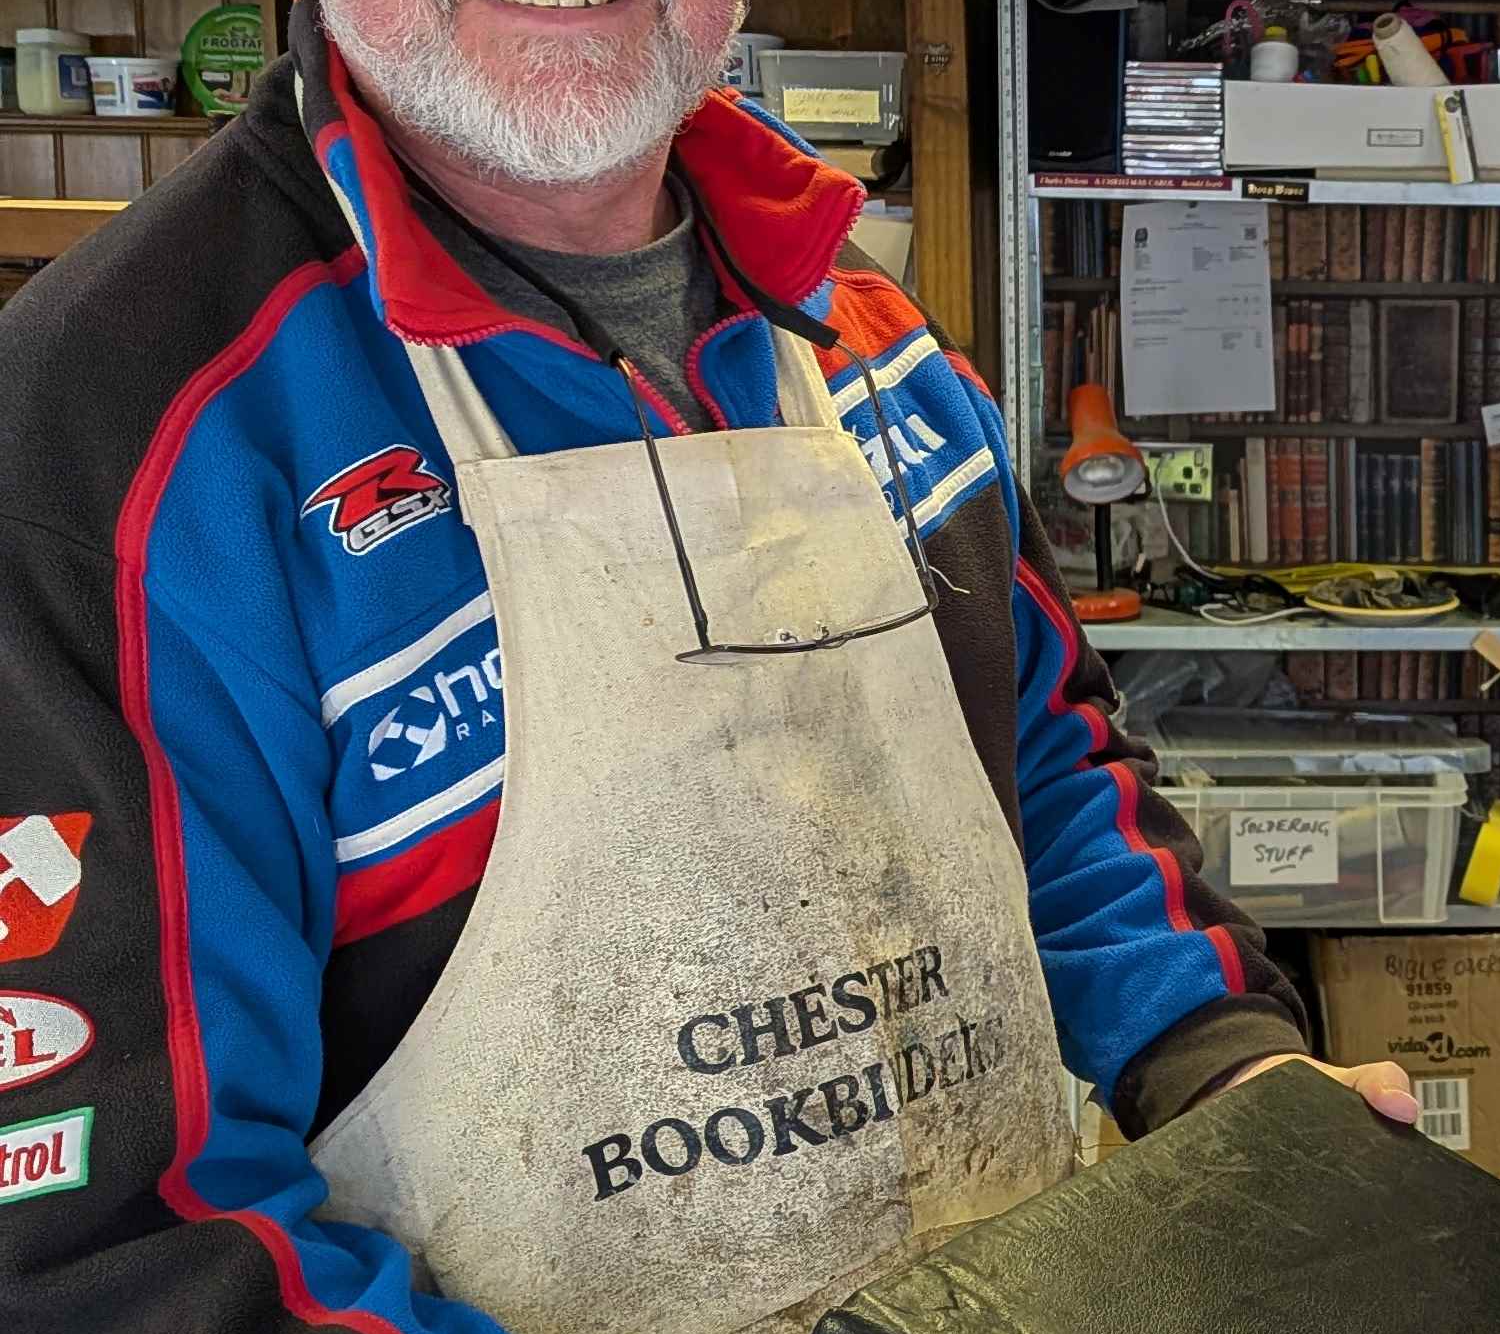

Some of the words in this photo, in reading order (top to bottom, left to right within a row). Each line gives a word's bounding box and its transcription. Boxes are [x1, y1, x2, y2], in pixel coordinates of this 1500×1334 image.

[349, 487, 449, 550] GSX
[1253, 843, 1314, 863] STUFF
[1406, 981, 1453, 997] 91859
[676, 945, 950, 1076] CHESTER
